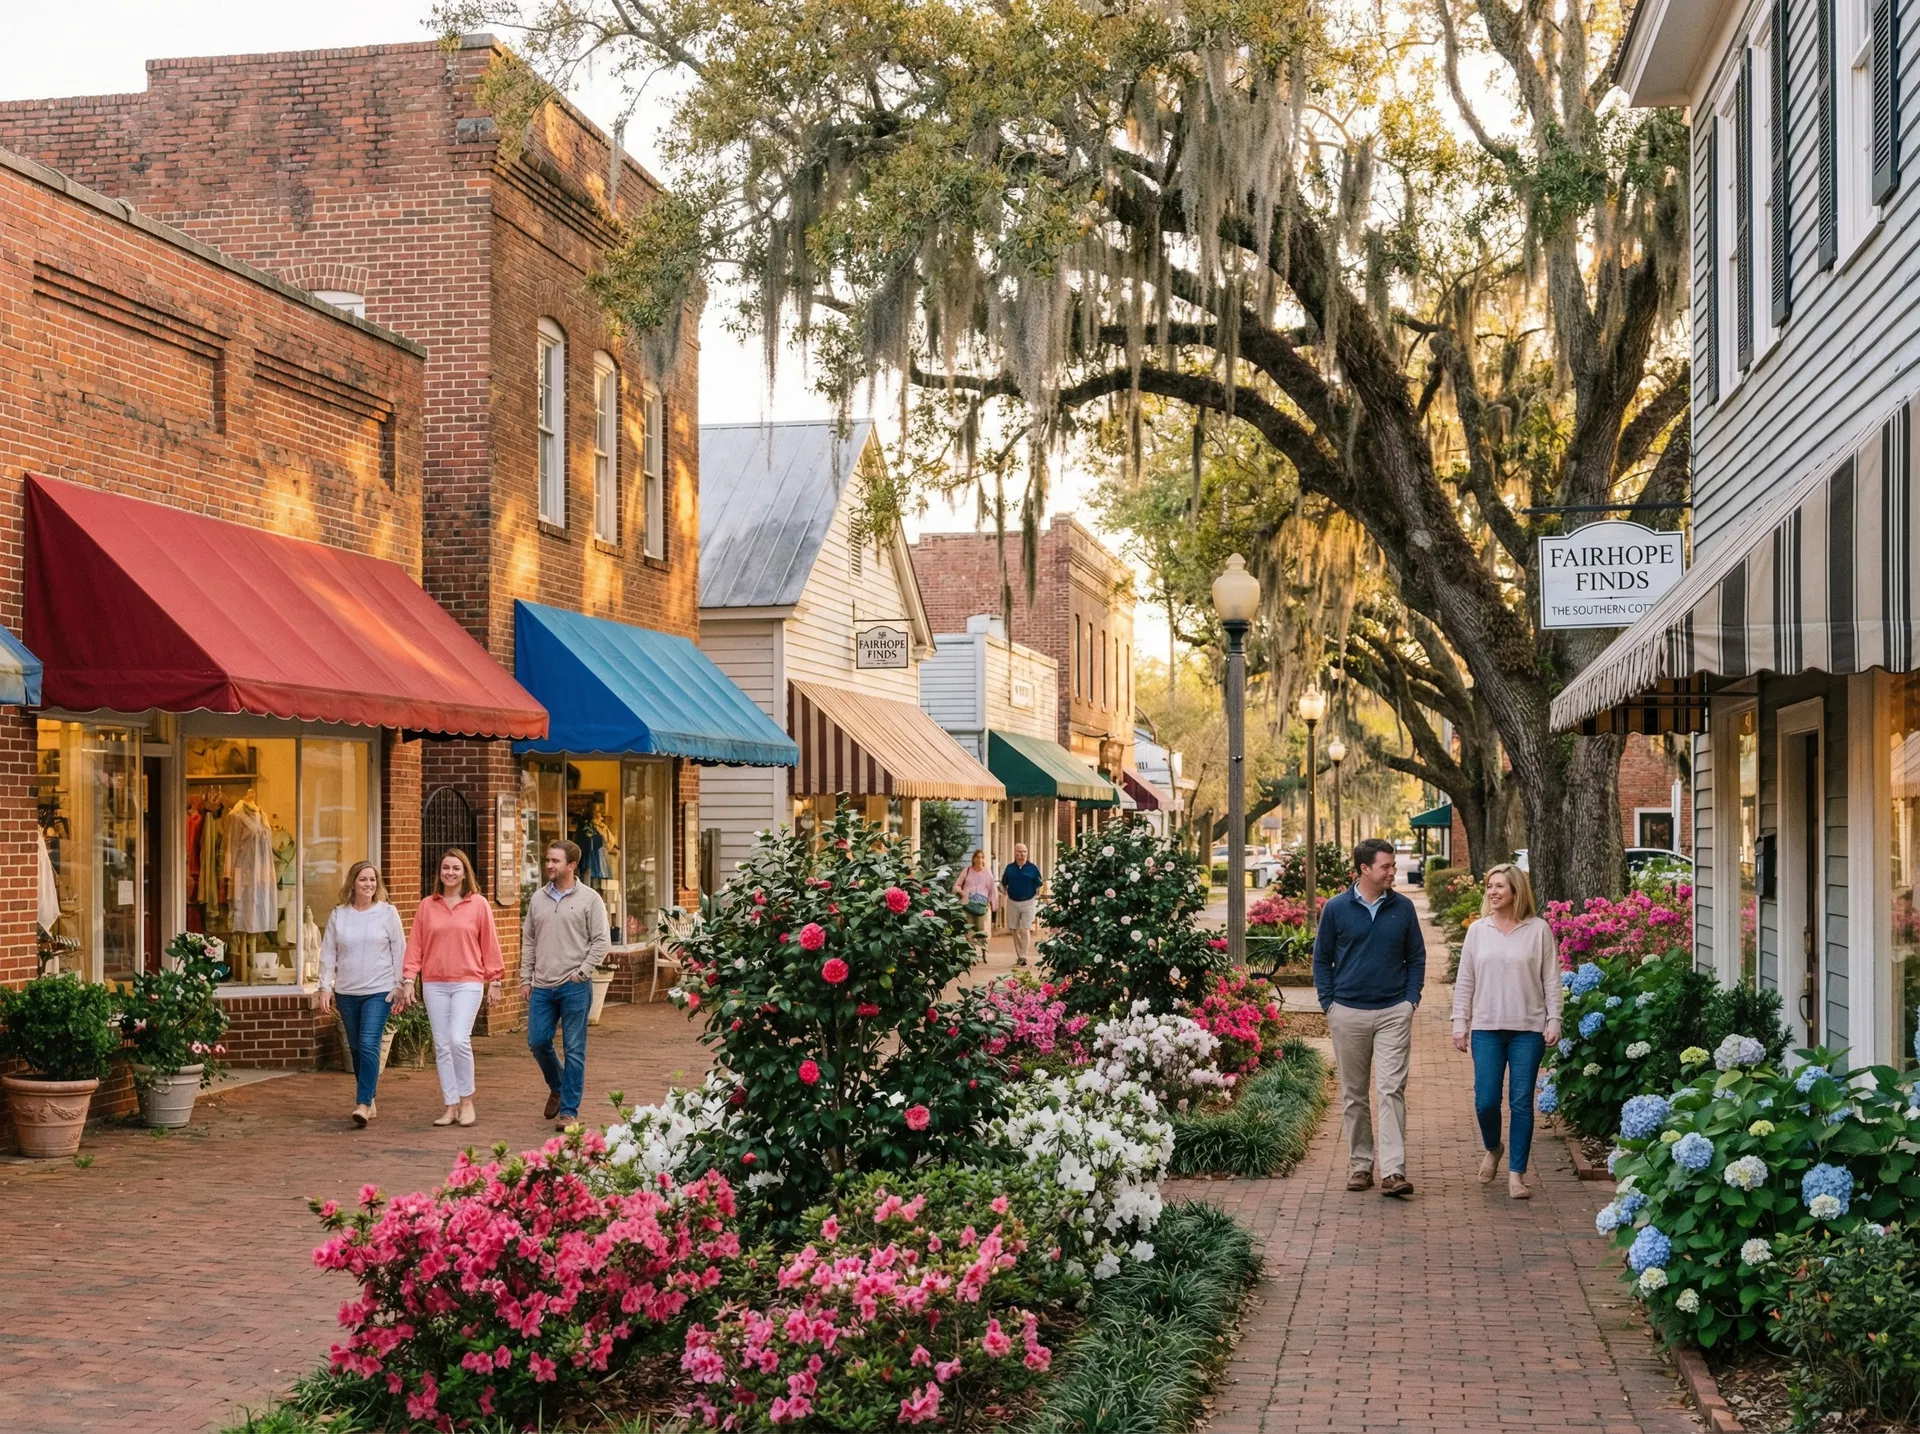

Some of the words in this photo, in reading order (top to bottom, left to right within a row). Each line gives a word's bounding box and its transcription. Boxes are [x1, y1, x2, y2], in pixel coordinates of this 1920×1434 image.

[1550, 545, 1674, 568] FAIRHOPE
[1576, 571, 1649, 591] FINDS
[1552, 606, 1571, 616] THE
[1573, 604, 1625, 615] SOUTHERN
[859, 640, 905, 649] FAIRHOPE
[868, 650, 897, 659] FINDS
